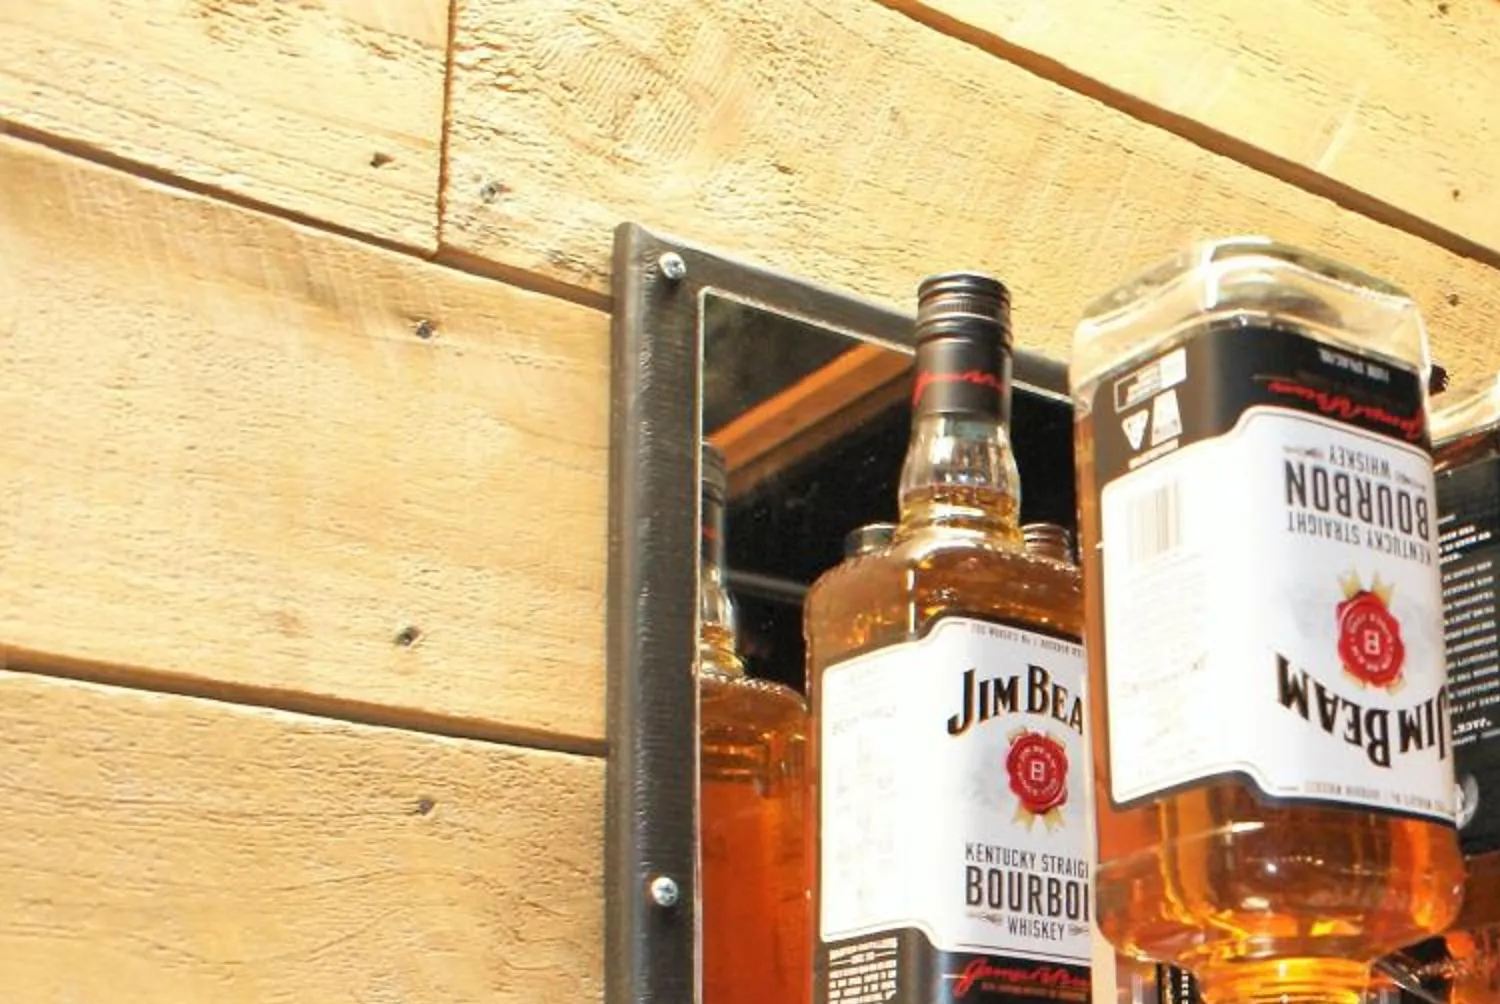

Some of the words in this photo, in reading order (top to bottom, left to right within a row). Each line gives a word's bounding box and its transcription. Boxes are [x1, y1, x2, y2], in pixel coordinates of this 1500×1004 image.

[1330, 445, 1391, 479] WHISKEY
[1285, 460, 1430, 541] BOURBON
[1288, 511, 1360, 545] STRAIGHT
[1367, 528, 1431, 566] KENTUCKY
[946, 667, 1020, 736] JIM
[1026, 664, 1083, 736] BEA
[1277, 652, 1392, 768] BEAM
[1400, 684, 1451, 760] JIM
[965, 842, 1037, 872] KENTUCKY
[1041, 854, 1089, 880] STRAIG
[1007, 916, 1065, 940] WHISKEY
